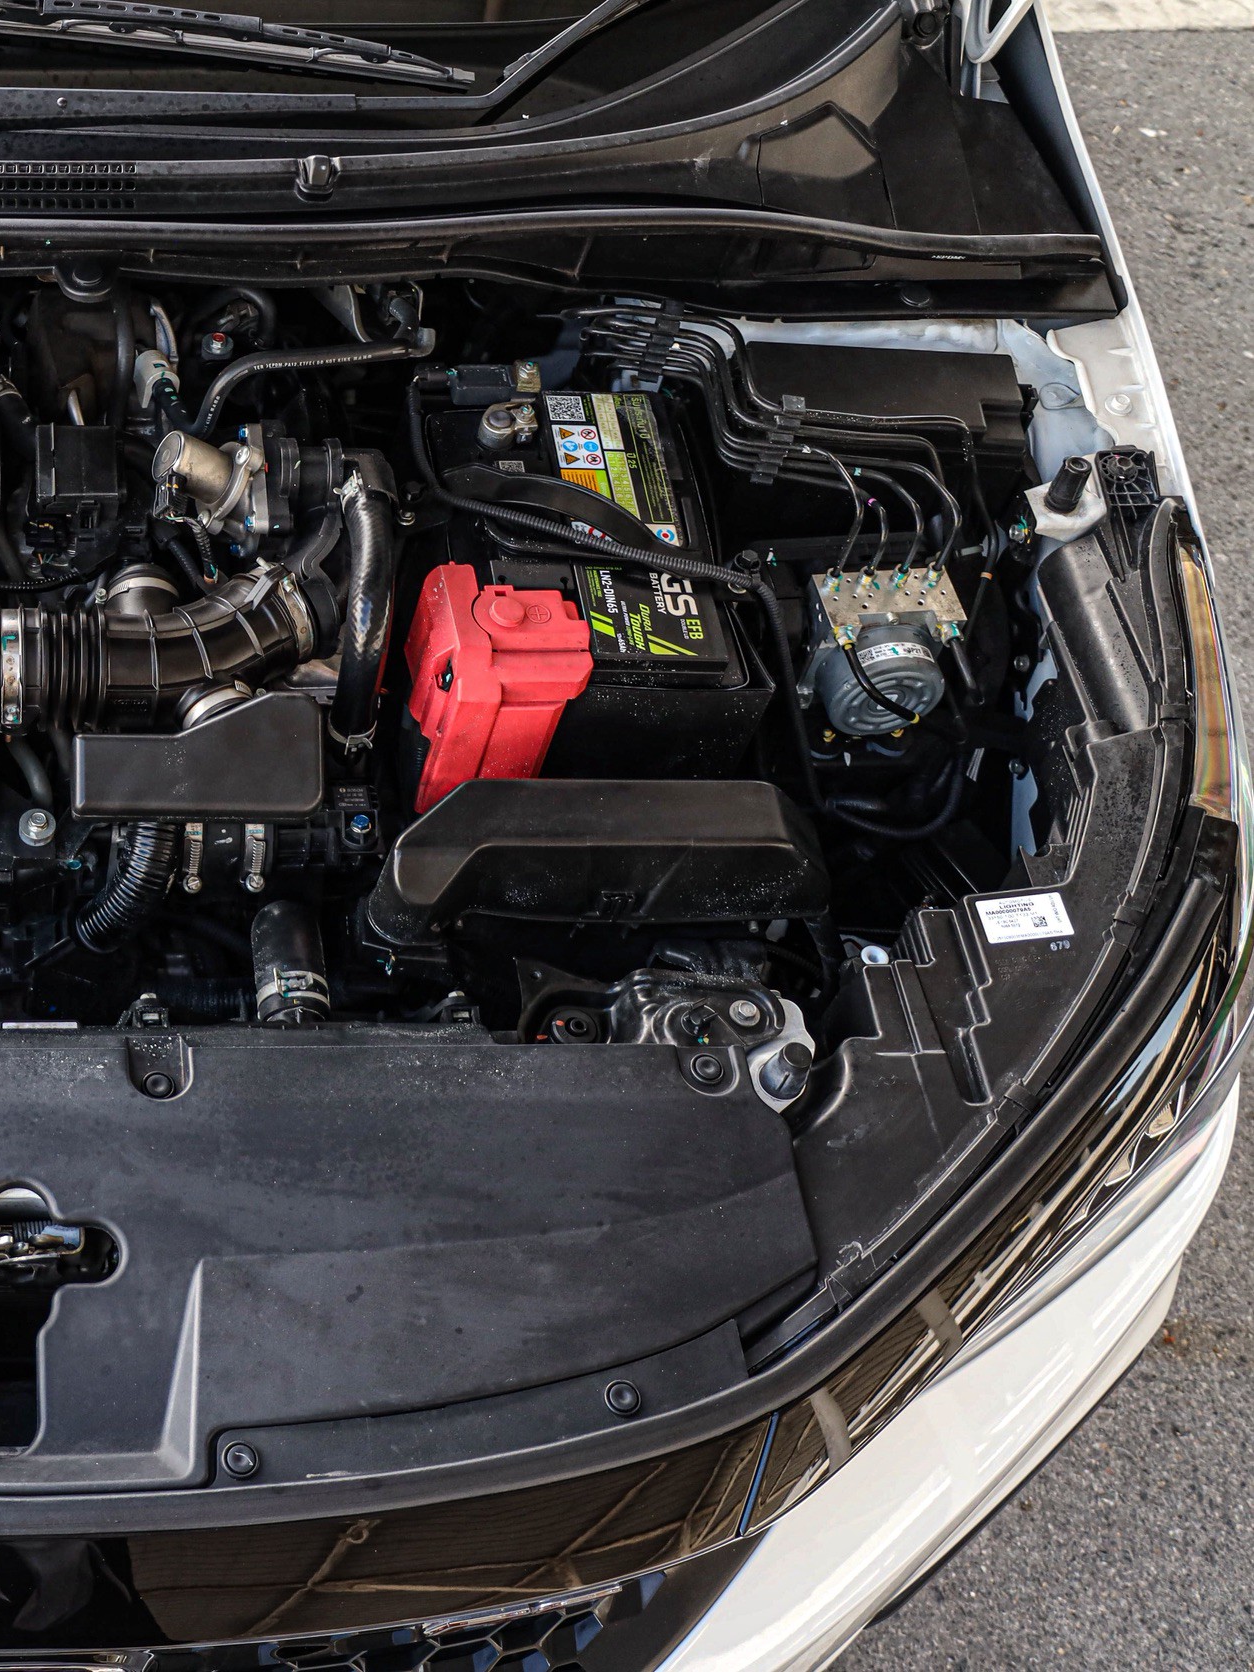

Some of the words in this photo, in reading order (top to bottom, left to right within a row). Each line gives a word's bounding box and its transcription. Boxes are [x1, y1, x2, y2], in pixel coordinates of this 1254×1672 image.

[599, 570, 619, 614] LN2-DIN65
[649, 572, 667, 615] BATTERY
[629, 612, 646, 651] TOUGH
[639, 603, 652, 632] DURA
[686, 618, 704, 640] EFB
[999, 901, 1034, 909] LIGHTING
